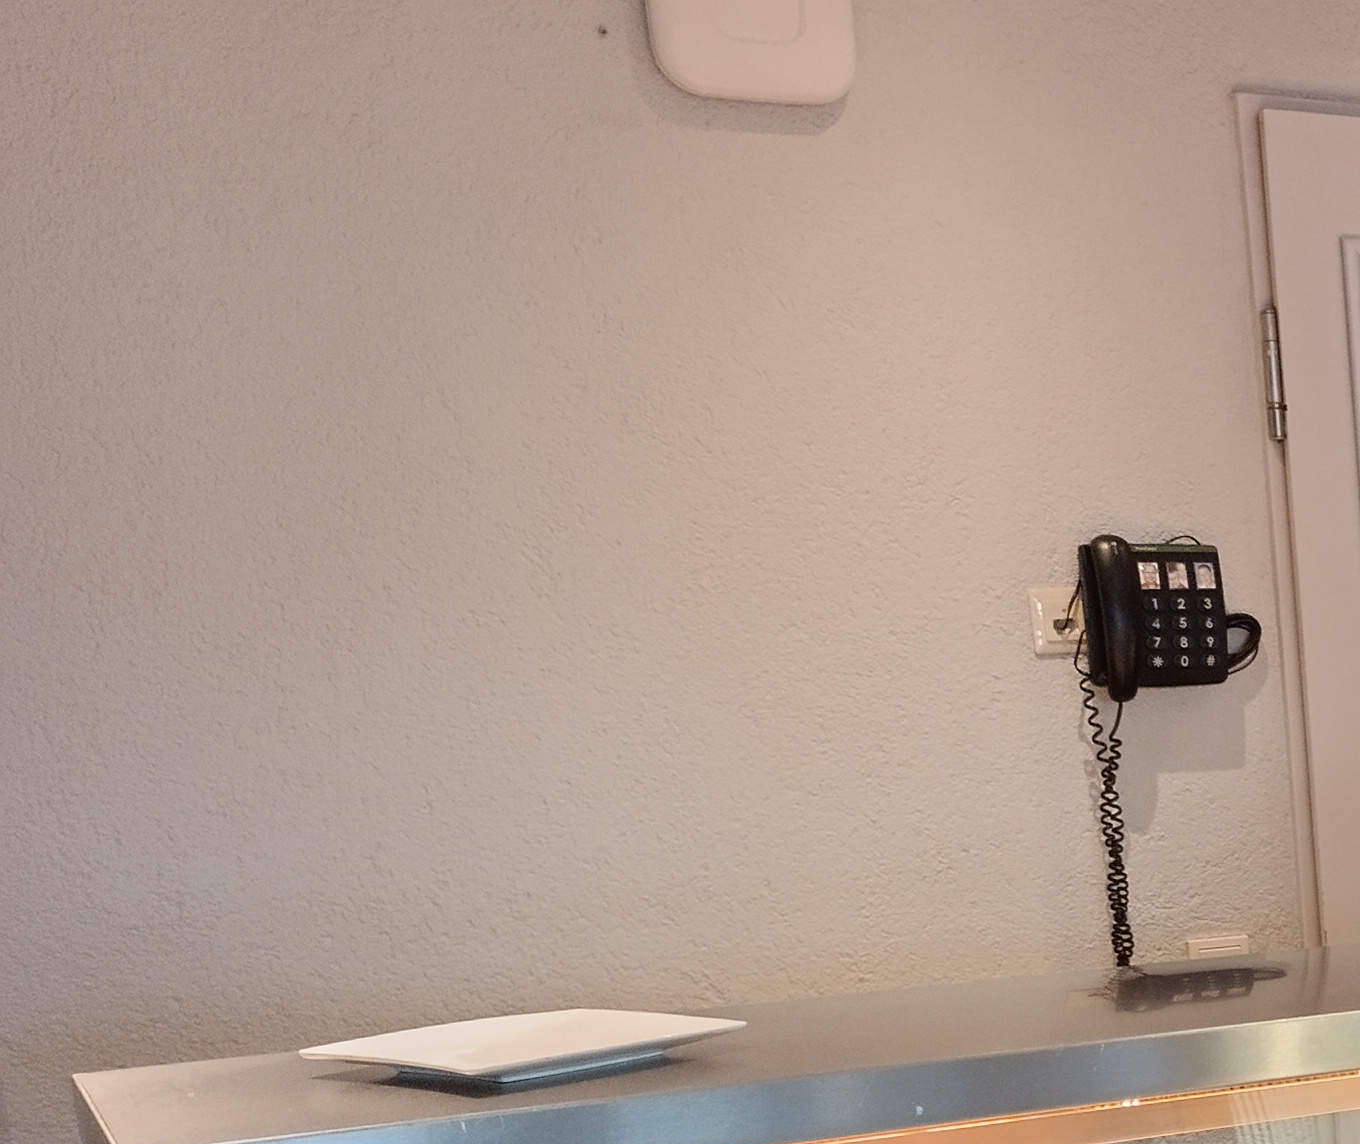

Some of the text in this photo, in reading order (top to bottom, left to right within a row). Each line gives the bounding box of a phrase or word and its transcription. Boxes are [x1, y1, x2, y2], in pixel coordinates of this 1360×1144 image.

[1151, 597, 1212, 609] 1 2 3
[1151, 617, 1213, 629] 4 5 6
[1153, 636, 1214, 648] 7 8 9
[1180, 655, 1188, 667] 0
